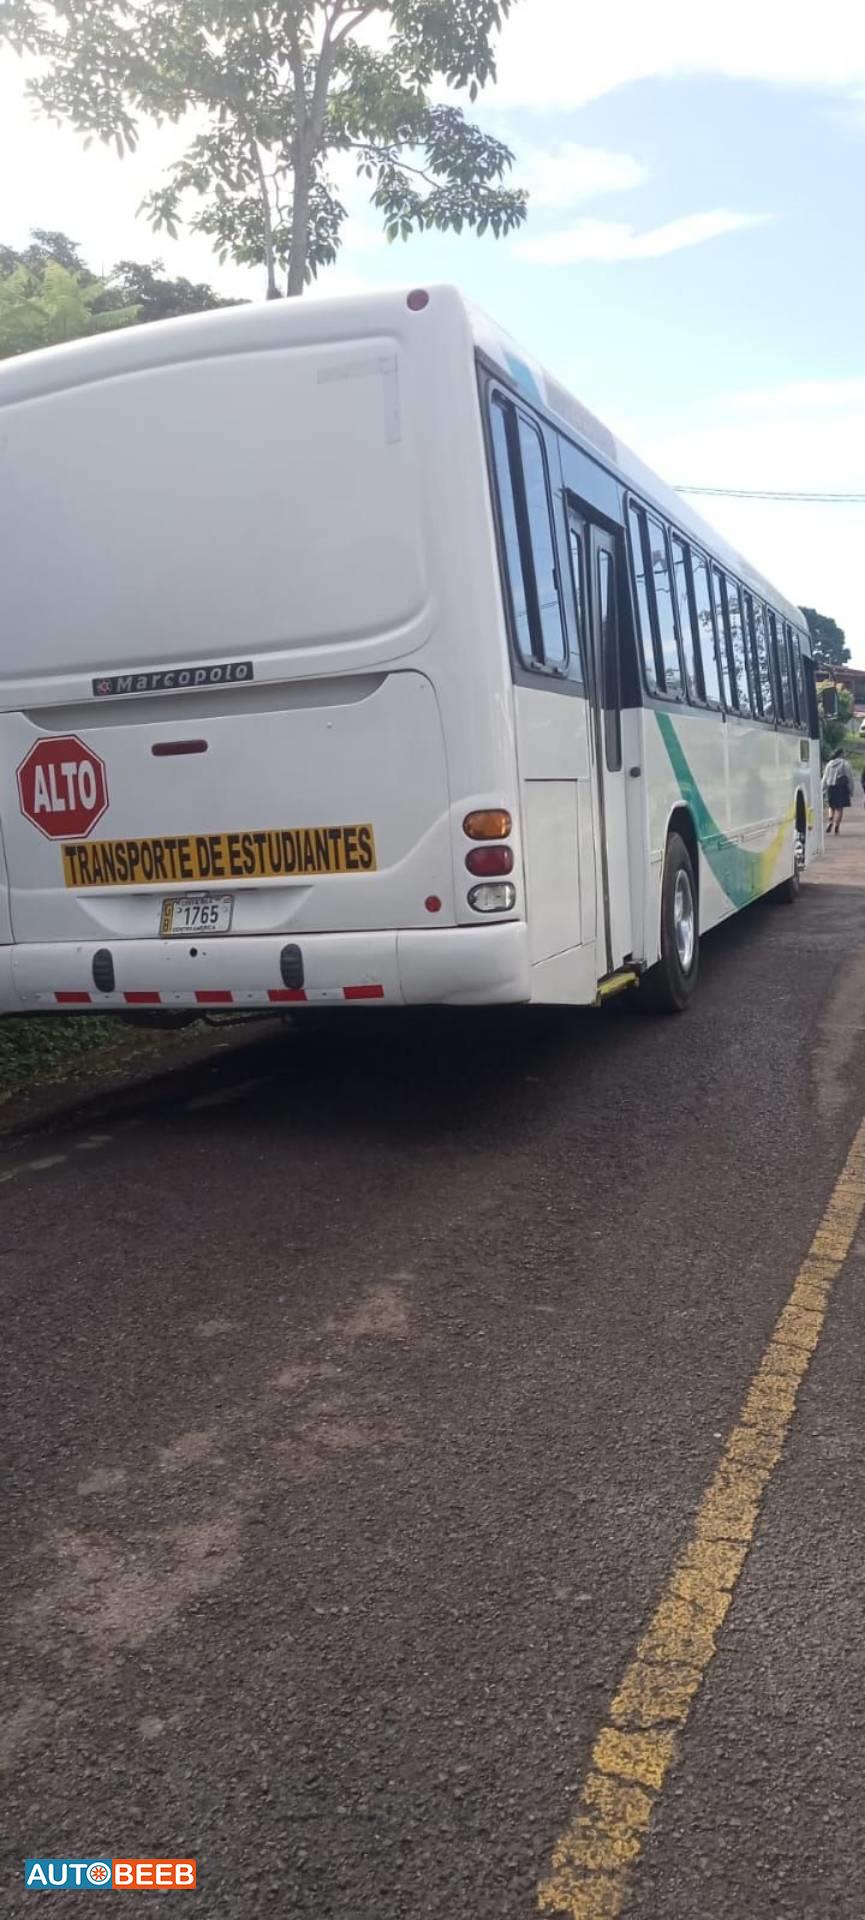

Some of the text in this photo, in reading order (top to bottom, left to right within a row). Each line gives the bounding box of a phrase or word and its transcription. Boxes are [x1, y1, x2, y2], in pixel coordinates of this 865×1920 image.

[116, 664, 248, 692] Marcopolo
[33, 760, 97, 813] ALTO
[65, 827, 374, 885] TRANSPORTE DE ESTUDIANTES
[184, 904, 219, 925] 1765
